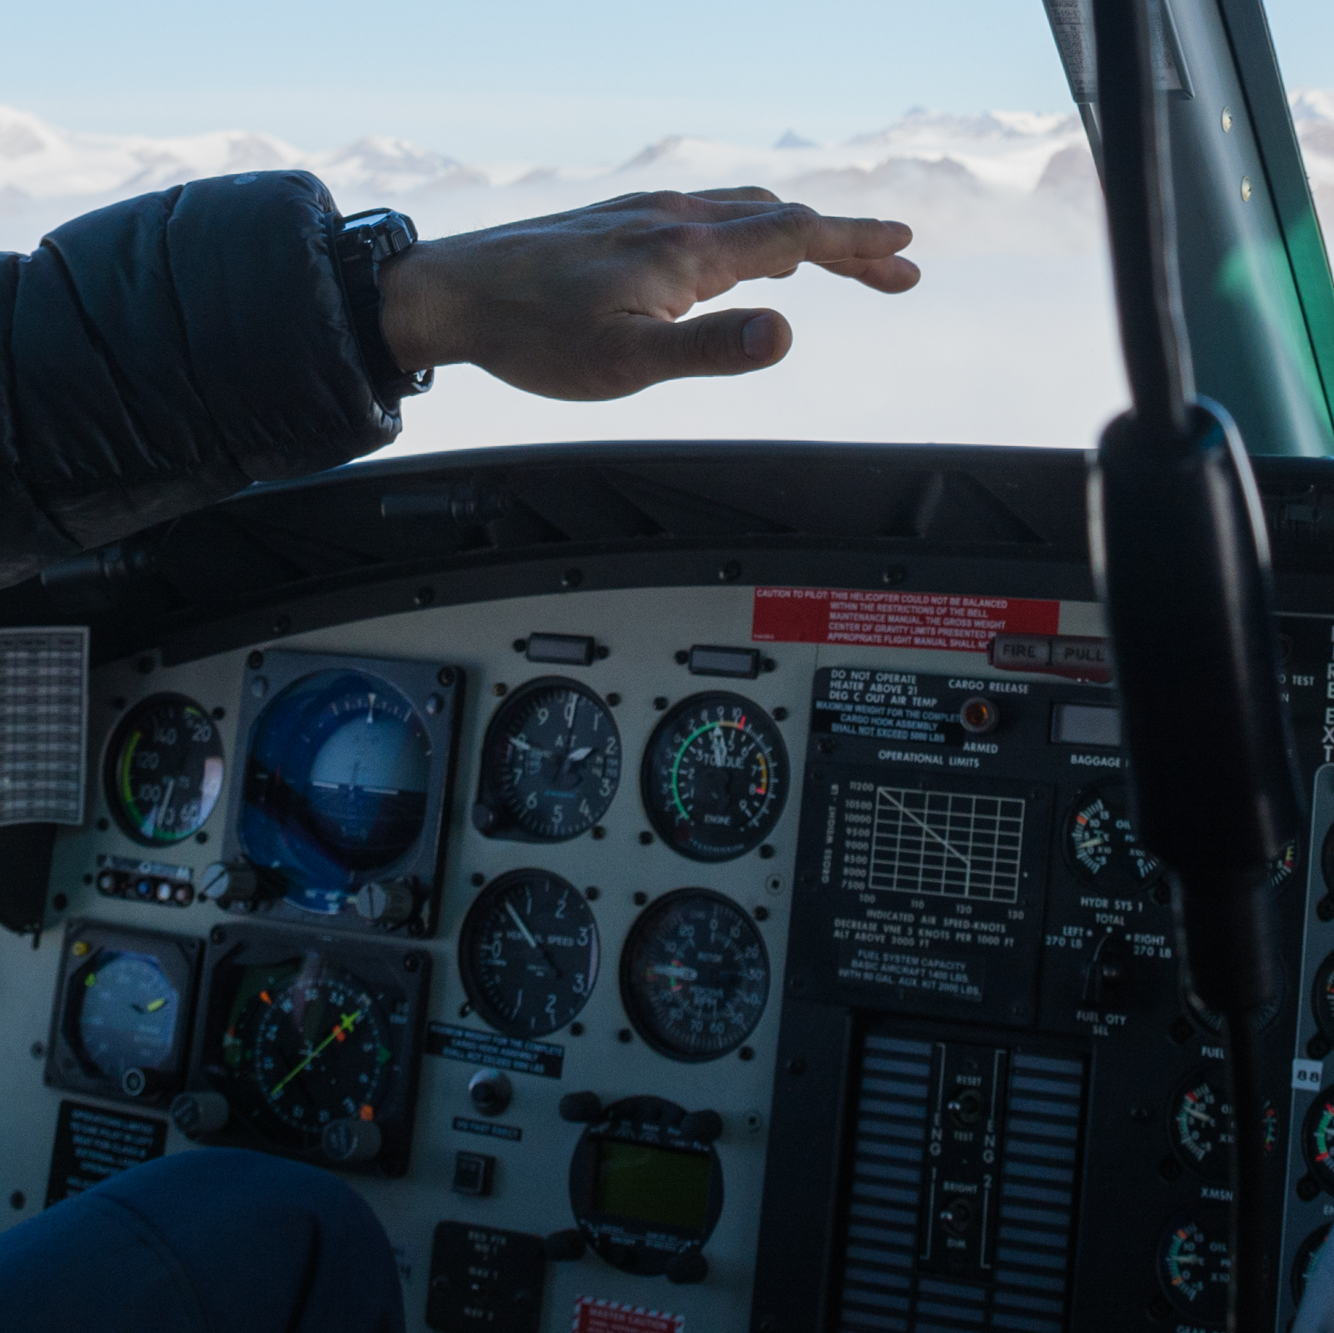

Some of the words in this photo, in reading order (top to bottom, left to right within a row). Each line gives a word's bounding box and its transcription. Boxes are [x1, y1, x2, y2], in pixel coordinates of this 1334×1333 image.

[757, 589, 789, 599] CAUTION
[792, 591, 802, 600] TO
[831, 592, 847, 602] THIS
[850, 593, 899, 604] HELICOPTER
[902, 595, 927, 605] COULD
[931, 597, 947, 606] NOT
[950, 597, 961, 607] BE
[964, 598, 1007, 608] BALANCED
[831, 602, 858, 611] WITHIN
[860, 603, 874, 612] THE
[877, 604, 933, 615] RESTRICTIONS
[937, 607, 947, 616] OF
[950, 607, 964, 617] THE
[967, 608, 987, 618] BELL
[830, 612, 885, 623] MAINTENANCE
[926, 617, 940, 626] THE
[943, 617, 971, 627] GROSS
[974, 619, 1006, 629] WEIGHT
[829, 622, 859, 632] CENTER
[862, 624, 873, 633] OF
[876, 625, 907, 635] GRAVITY
[910, 626, 935, 636] LIMITS
[938, 628, 985, 638] PRESENTED
[828, 632, 881, 643] APPROPRIATE
[884, 635, 911, 645] FLIGHT
[915, 637, 946, 647] MANUAL
[950, 638, 973, 648] SHALL
[1003, 644, 1035, 658] FIRE
[1064, 647, 1104, 661] PULL
[831, 669, 846, 679] DO
[851, 670, 870, 681] NOT
[876, 673, 916, 684] OPERATE
[1292, 675, 1314, 686] TEST
[830, 680, 864, 691] HEATER
[870, 682, 902, 694] ABOVE
[908, 685, 917, 695] 21
[948, 679, 984, 691] CARGO
[989, 682, 1029, 694] RELEASE
[829, 690, 848, 701] DEG
[854, 692, 860, 702] C
[866, 693, 884, 703] OUT
[890, 695, 906, 705] AIR
[912, 697, 937, 707] TEMP
[963, 742, 998, 754] ARMED
[878, 750, 943, 765] OPERATIONAL
[949, 756, 979, 768] LIMITS
[1070, 754, 1121, 767] BAGGAGE
[1081, 897, 1109, 910] HYDR
[1115, 899, 1133, 911] SYS
[866, 909, 915, 923] INDICATED
[921, 915, 936, 925] AIR
[943, 917, 1006, 933] SPEED-KNOTS
[1095, 914, 1125, 926] TOTAL
[1063, 926, 1084, 937] LEFT
[1046, 936, 1066, 947] 270
[1071, 937, 1083, 949] LB
[1134, 934, 1165, 946] RIGHT
[1134, 945, 1155, 957] 270
[1159, 947, 1171, 959] LB
[1077, 1010, 1100, 1023] FUEL
[1105, 1014, 1126, 1026] QTY
[1092, 1025, 1109, 1036] SEL
[1201, 1046, 1225, 1060] FUEL
[956, 1075, 982, 1086] RESET
[1298, 1070, 1320, 1084] 88
[953, 1131, 974, 1142] TEST
[1201, 1188, 1234, 1201] XMSN
